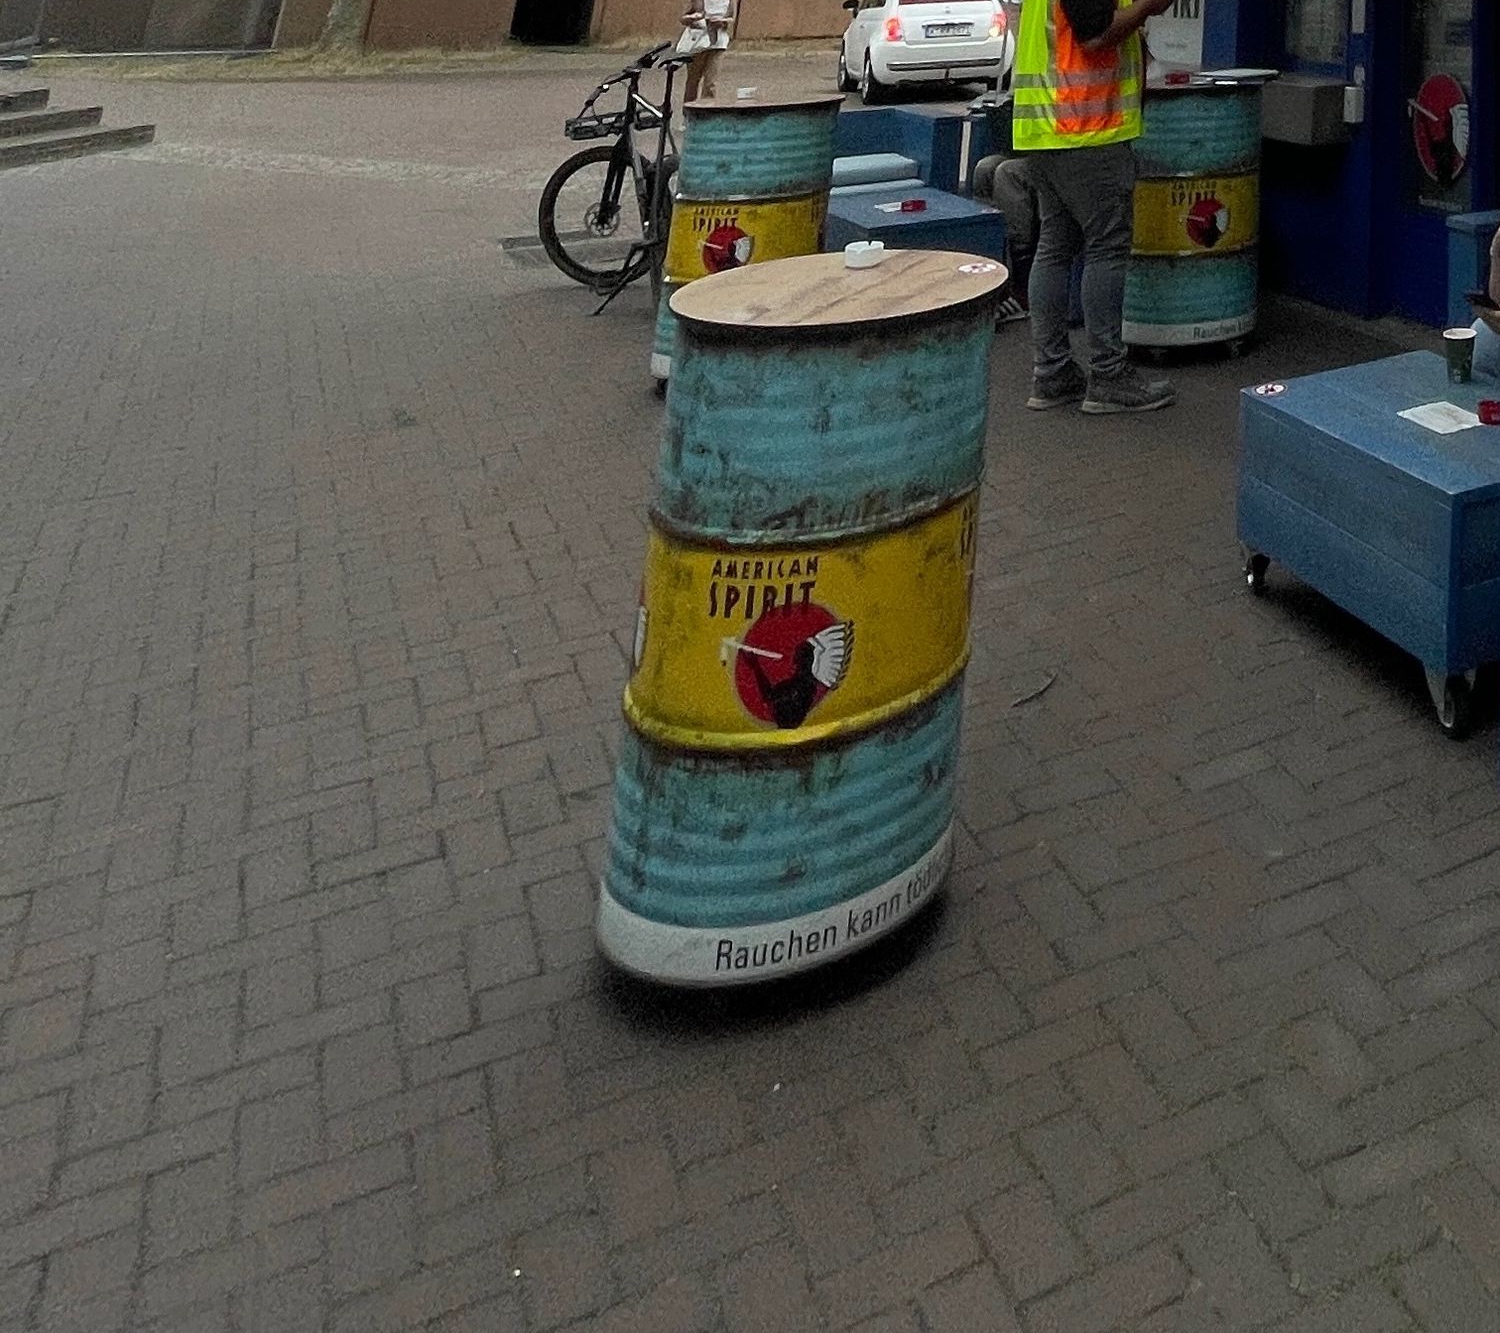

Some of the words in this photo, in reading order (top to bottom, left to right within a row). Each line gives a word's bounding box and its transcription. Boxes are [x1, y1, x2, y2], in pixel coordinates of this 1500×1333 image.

[711, 556, 819, 580] AMERICAN
[708, 580, 817, 620] SPIRIT
[715, 925, 838, 971] Rauchen
[846, 892, 902, 940] kann
